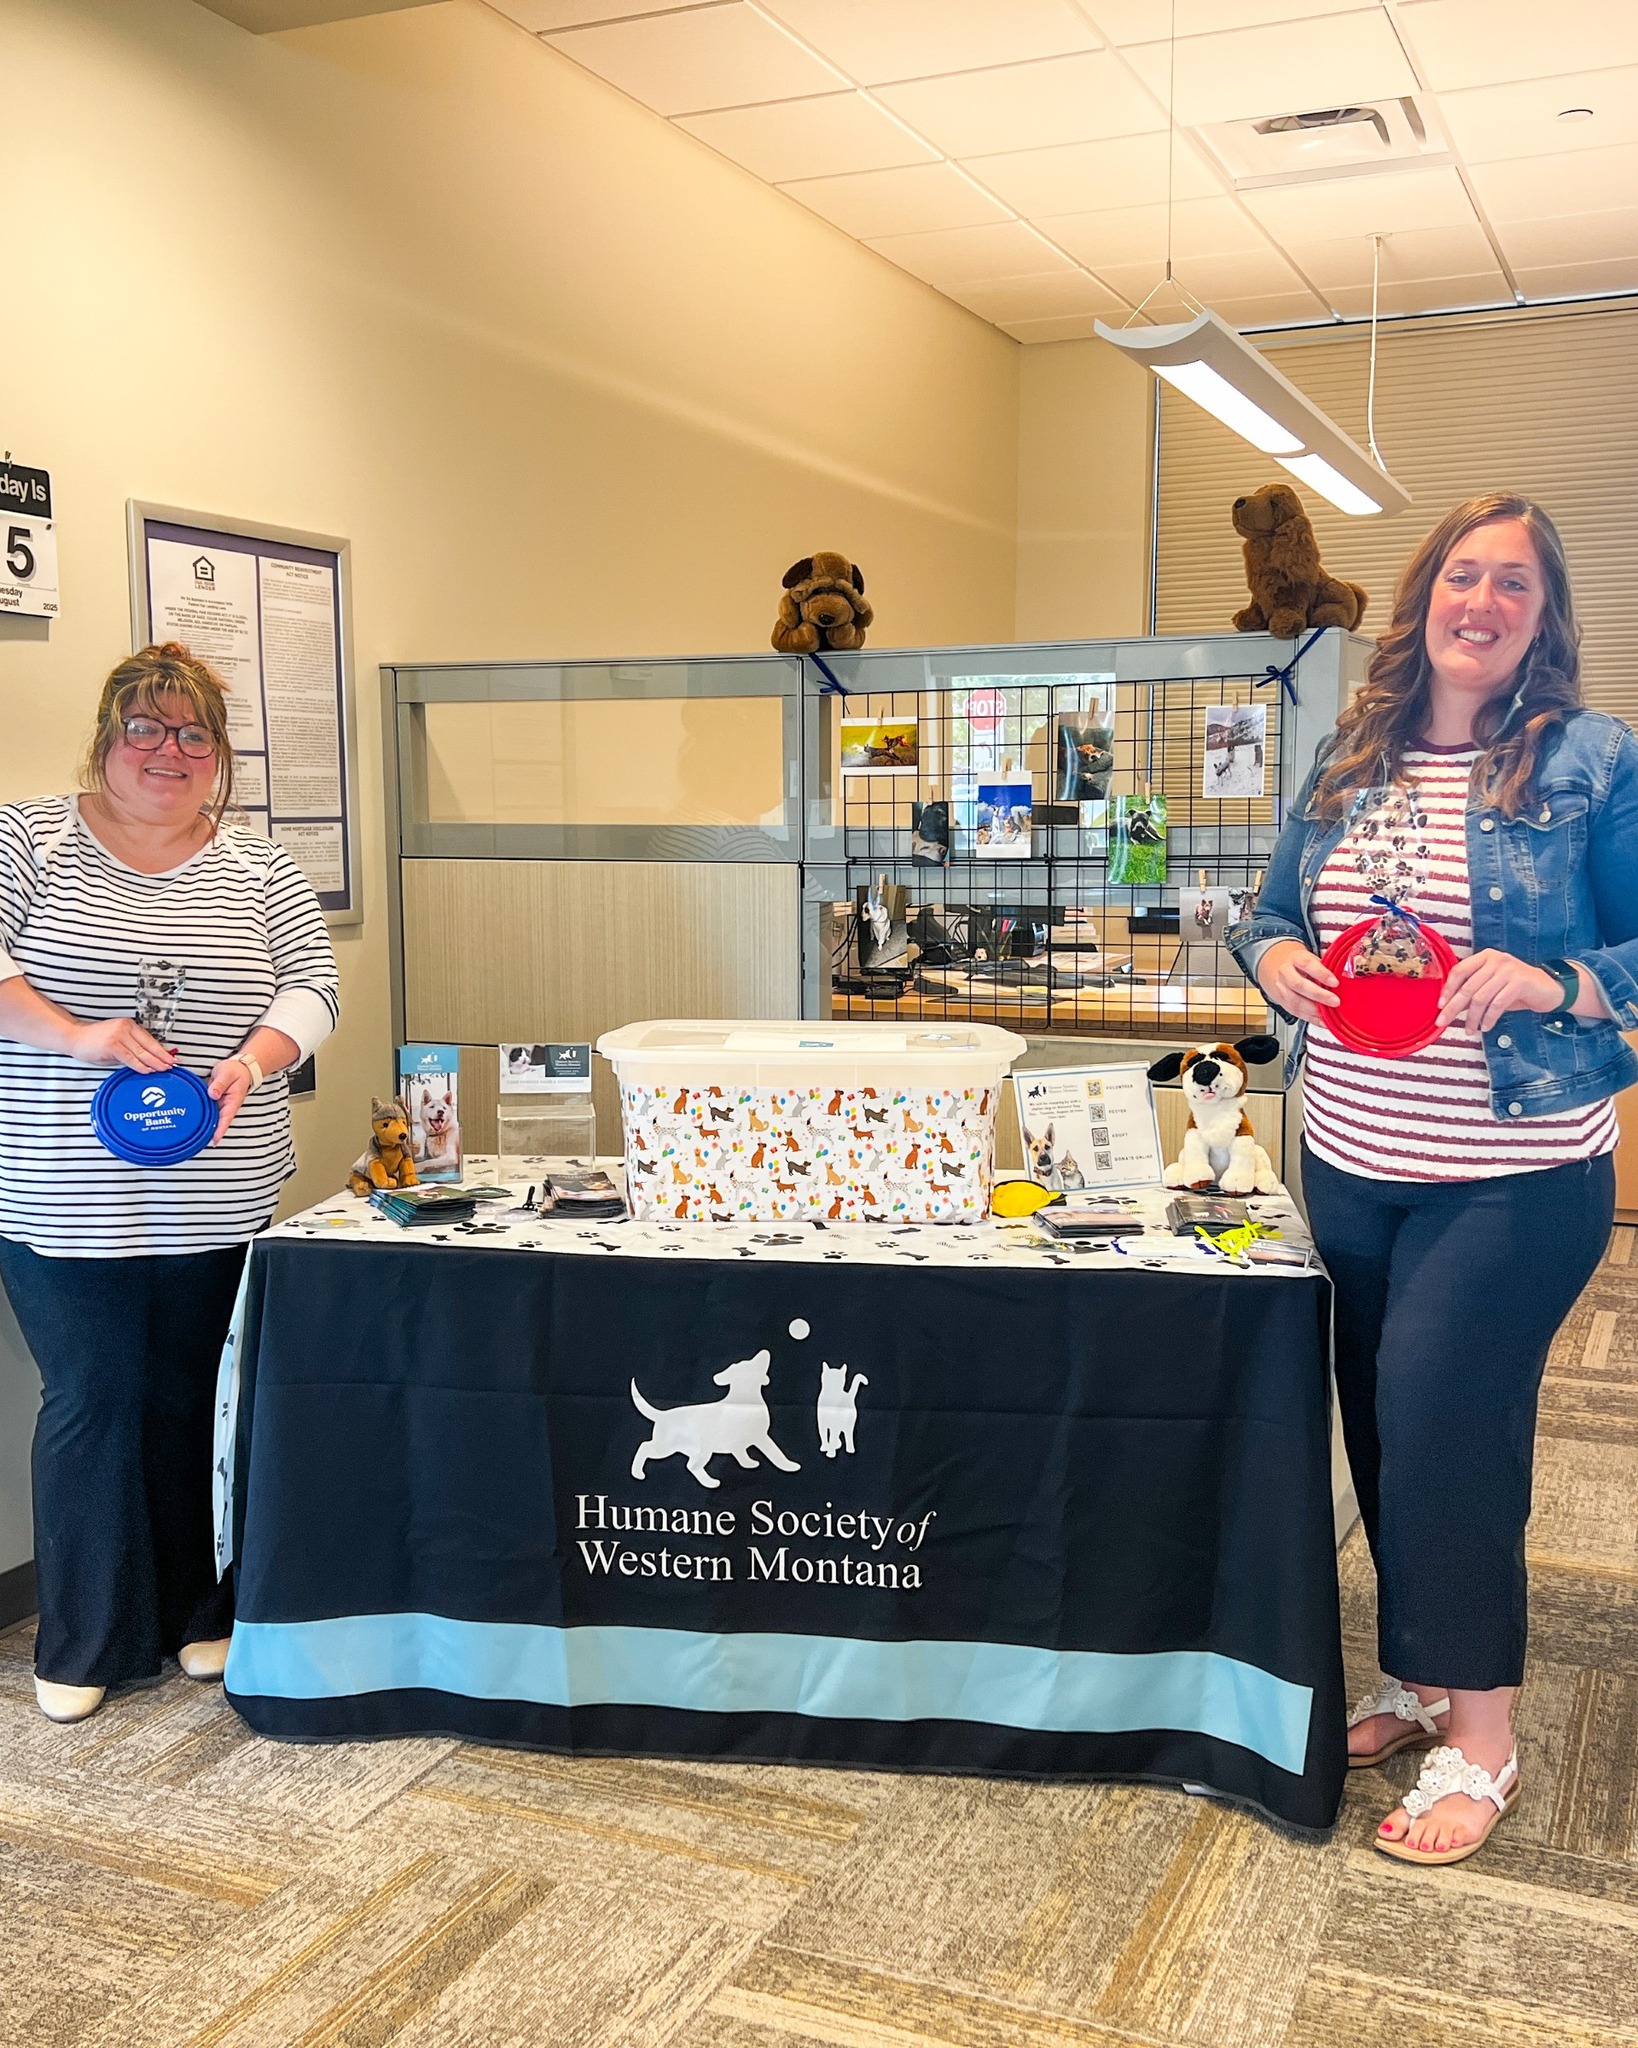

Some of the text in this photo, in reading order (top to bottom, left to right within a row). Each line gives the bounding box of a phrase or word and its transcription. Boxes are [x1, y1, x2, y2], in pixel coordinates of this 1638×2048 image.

[31, 478, 47, 502] Is
[6, 526, 34, 578] 5
[43, 602, 58, 611] 2025
[124, 1107, 186, 1121] Opportunity
[145, 1117, 172, 1126] Bank
[574, 1494, 937, 1551] Humane Society of
[576, 1540, 923, 1589] Western Montana
